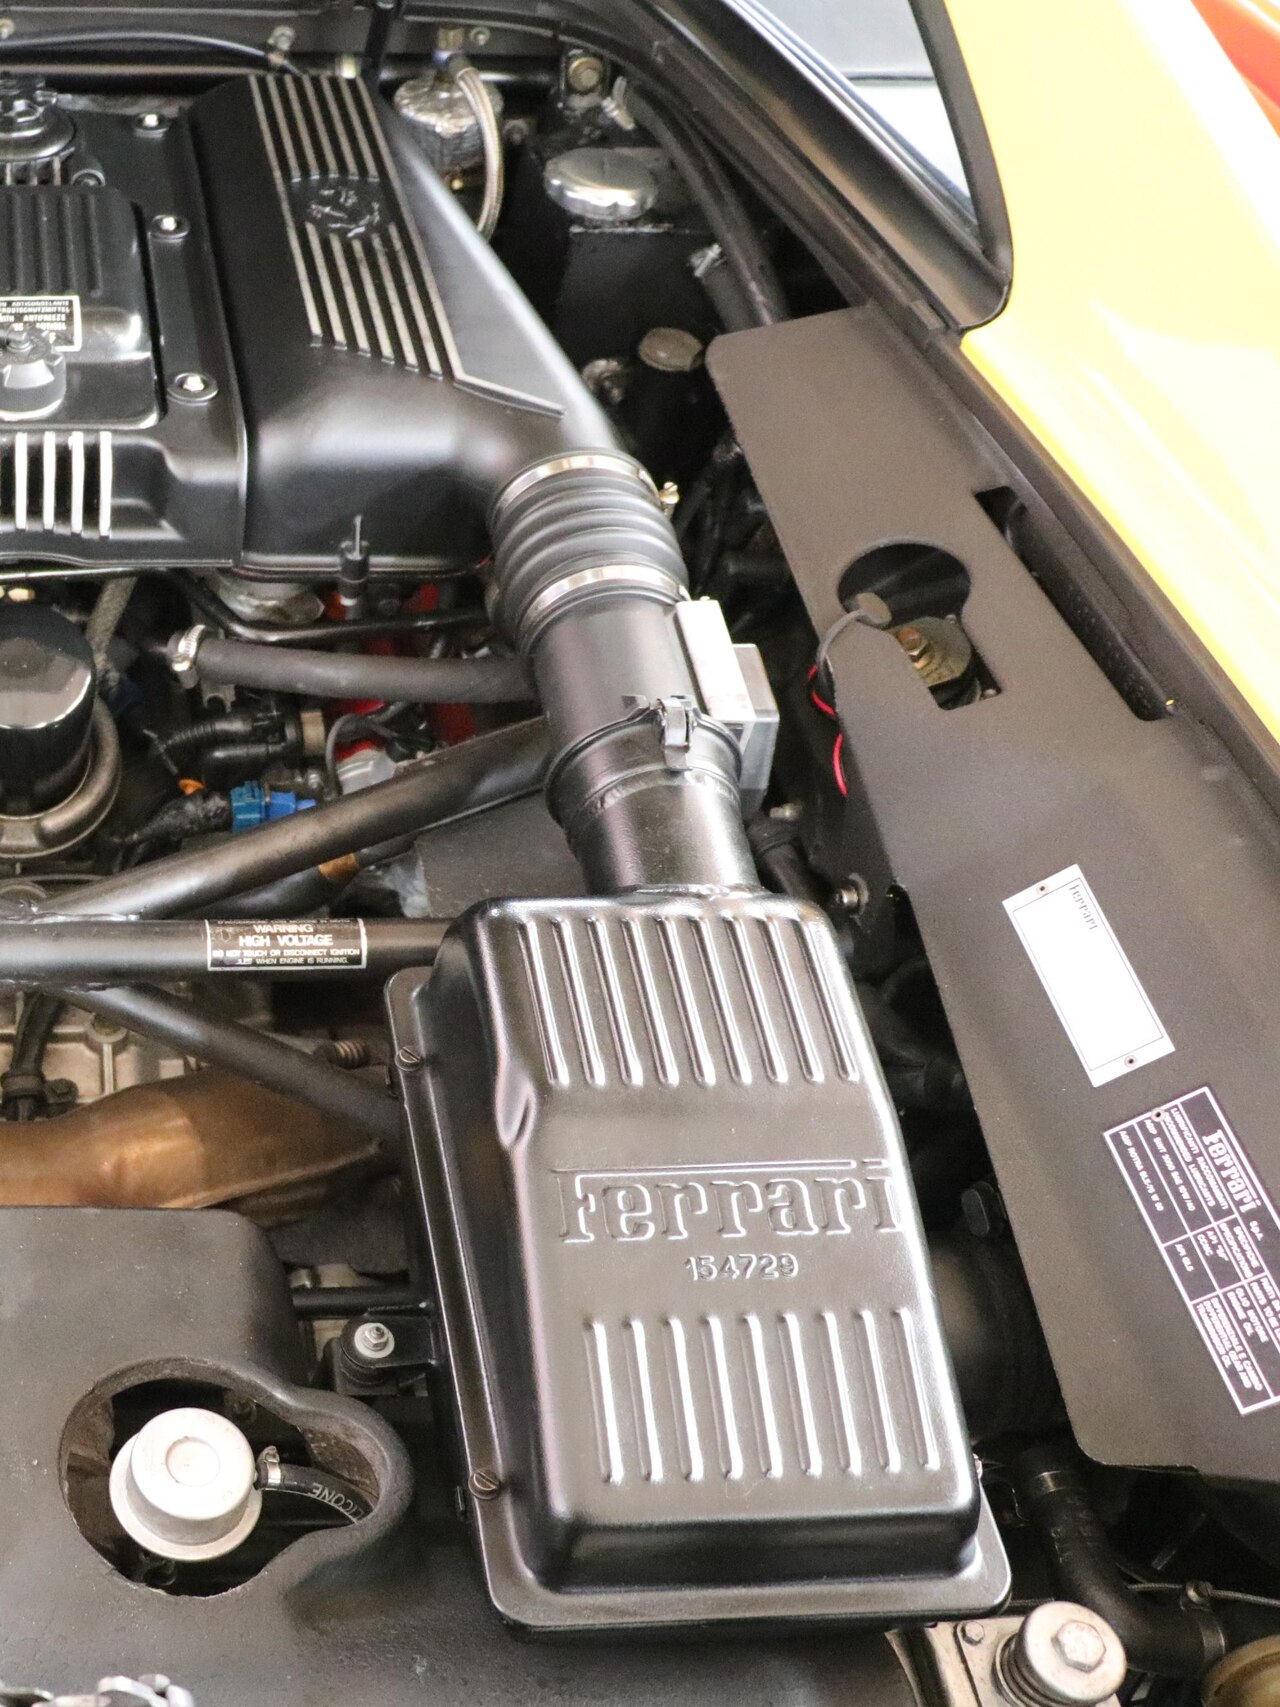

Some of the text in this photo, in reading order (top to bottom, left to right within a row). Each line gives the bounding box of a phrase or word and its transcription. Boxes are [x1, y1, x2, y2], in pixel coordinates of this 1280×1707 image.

[239, 934, 334, 947] HIGH VOLTAGE
[253, 924, 314, 934] WARNING
[1201, 1129, 1261, 1213] Ferrari
[552, 1158, 905, 1243] Ferrari
[684, 1253, 800, 1282] 154729
[1246, 1308, 1268, 1342] MOTORE
